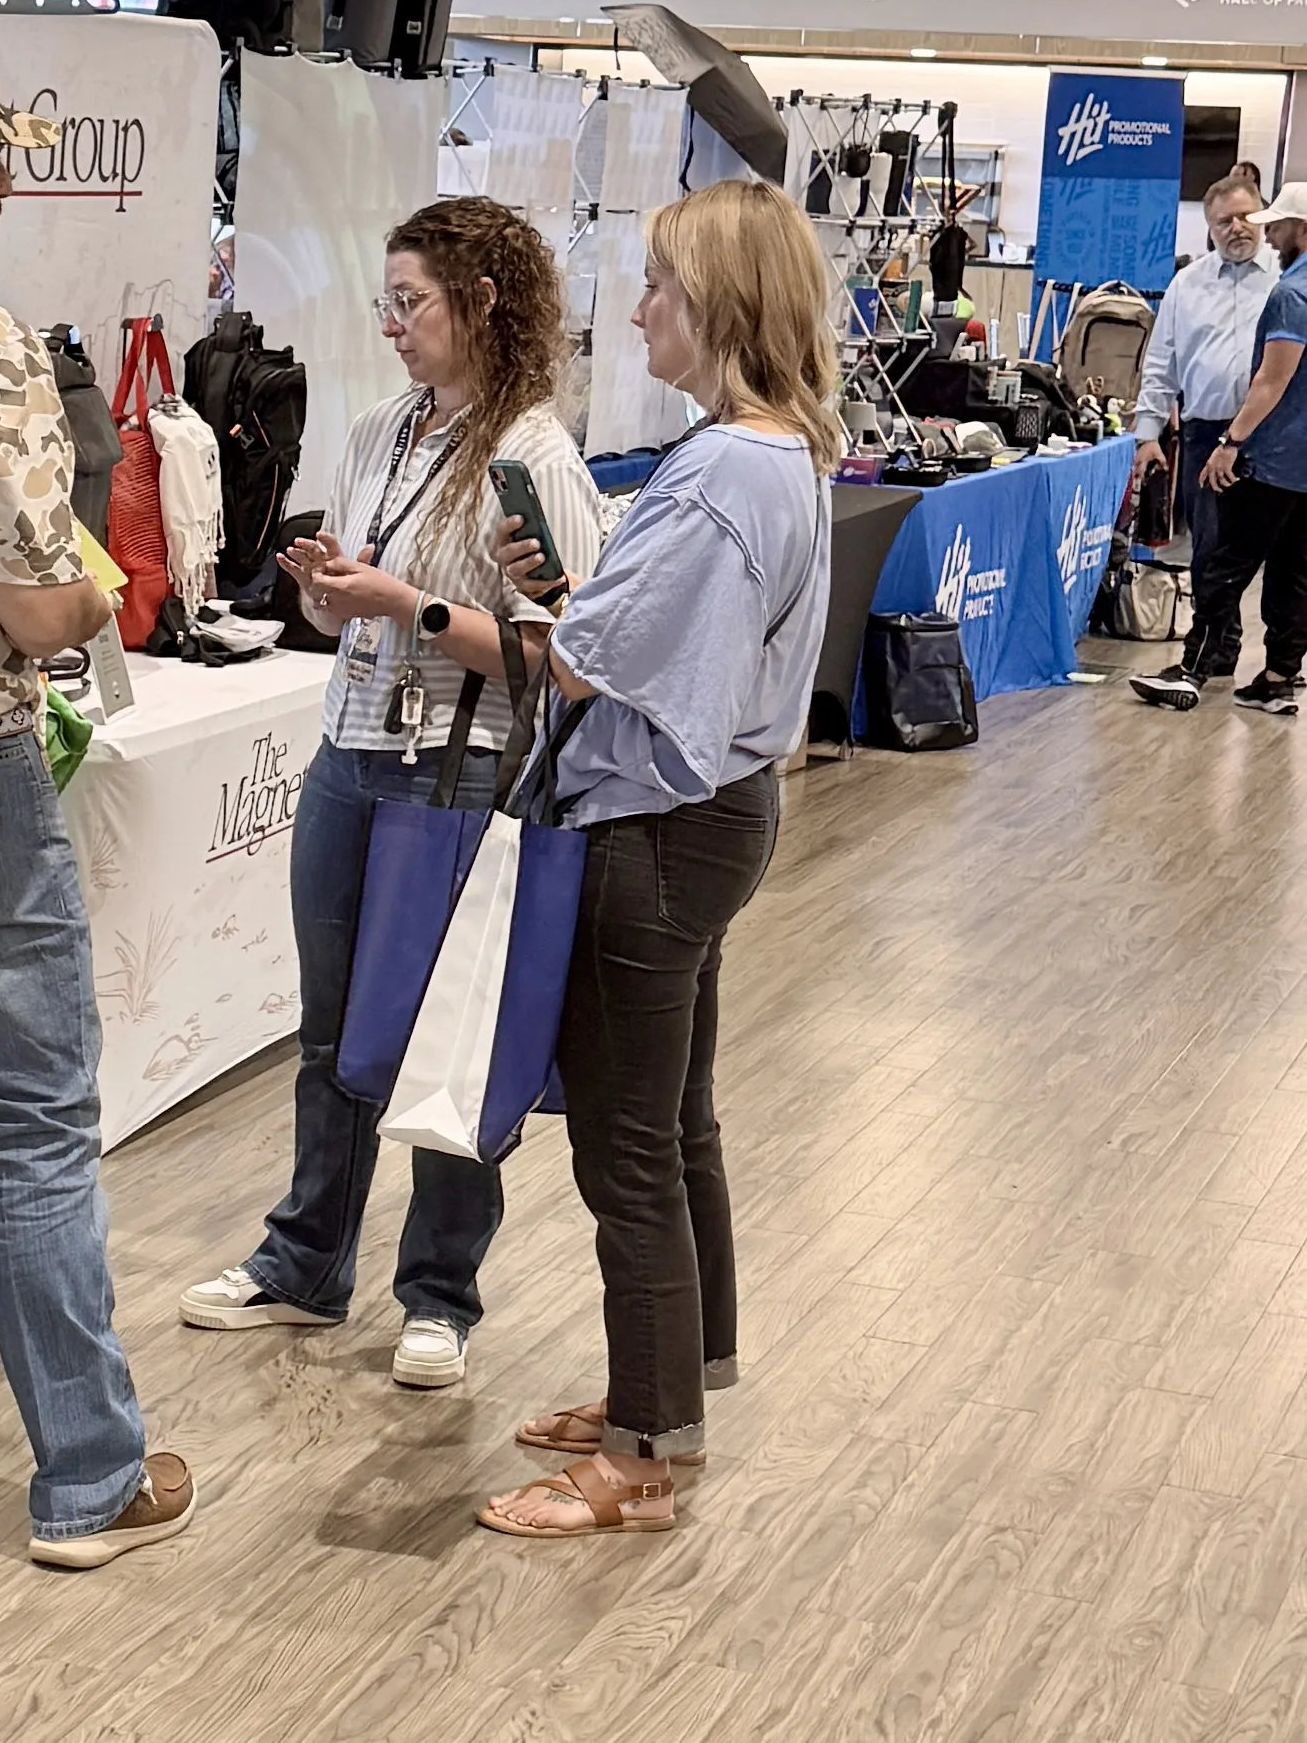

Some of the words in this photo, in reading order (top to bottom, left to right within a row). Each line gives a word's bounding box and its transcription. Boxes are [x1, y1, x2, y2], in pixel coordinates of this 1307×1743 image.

[1058, 93, 1111, 166] Hit
[1108, 120, 1170, 135] PROMOTIONAL
[1108, 133, 1153, 146] PRODUCTS
[250, 730, 288, 787] The
